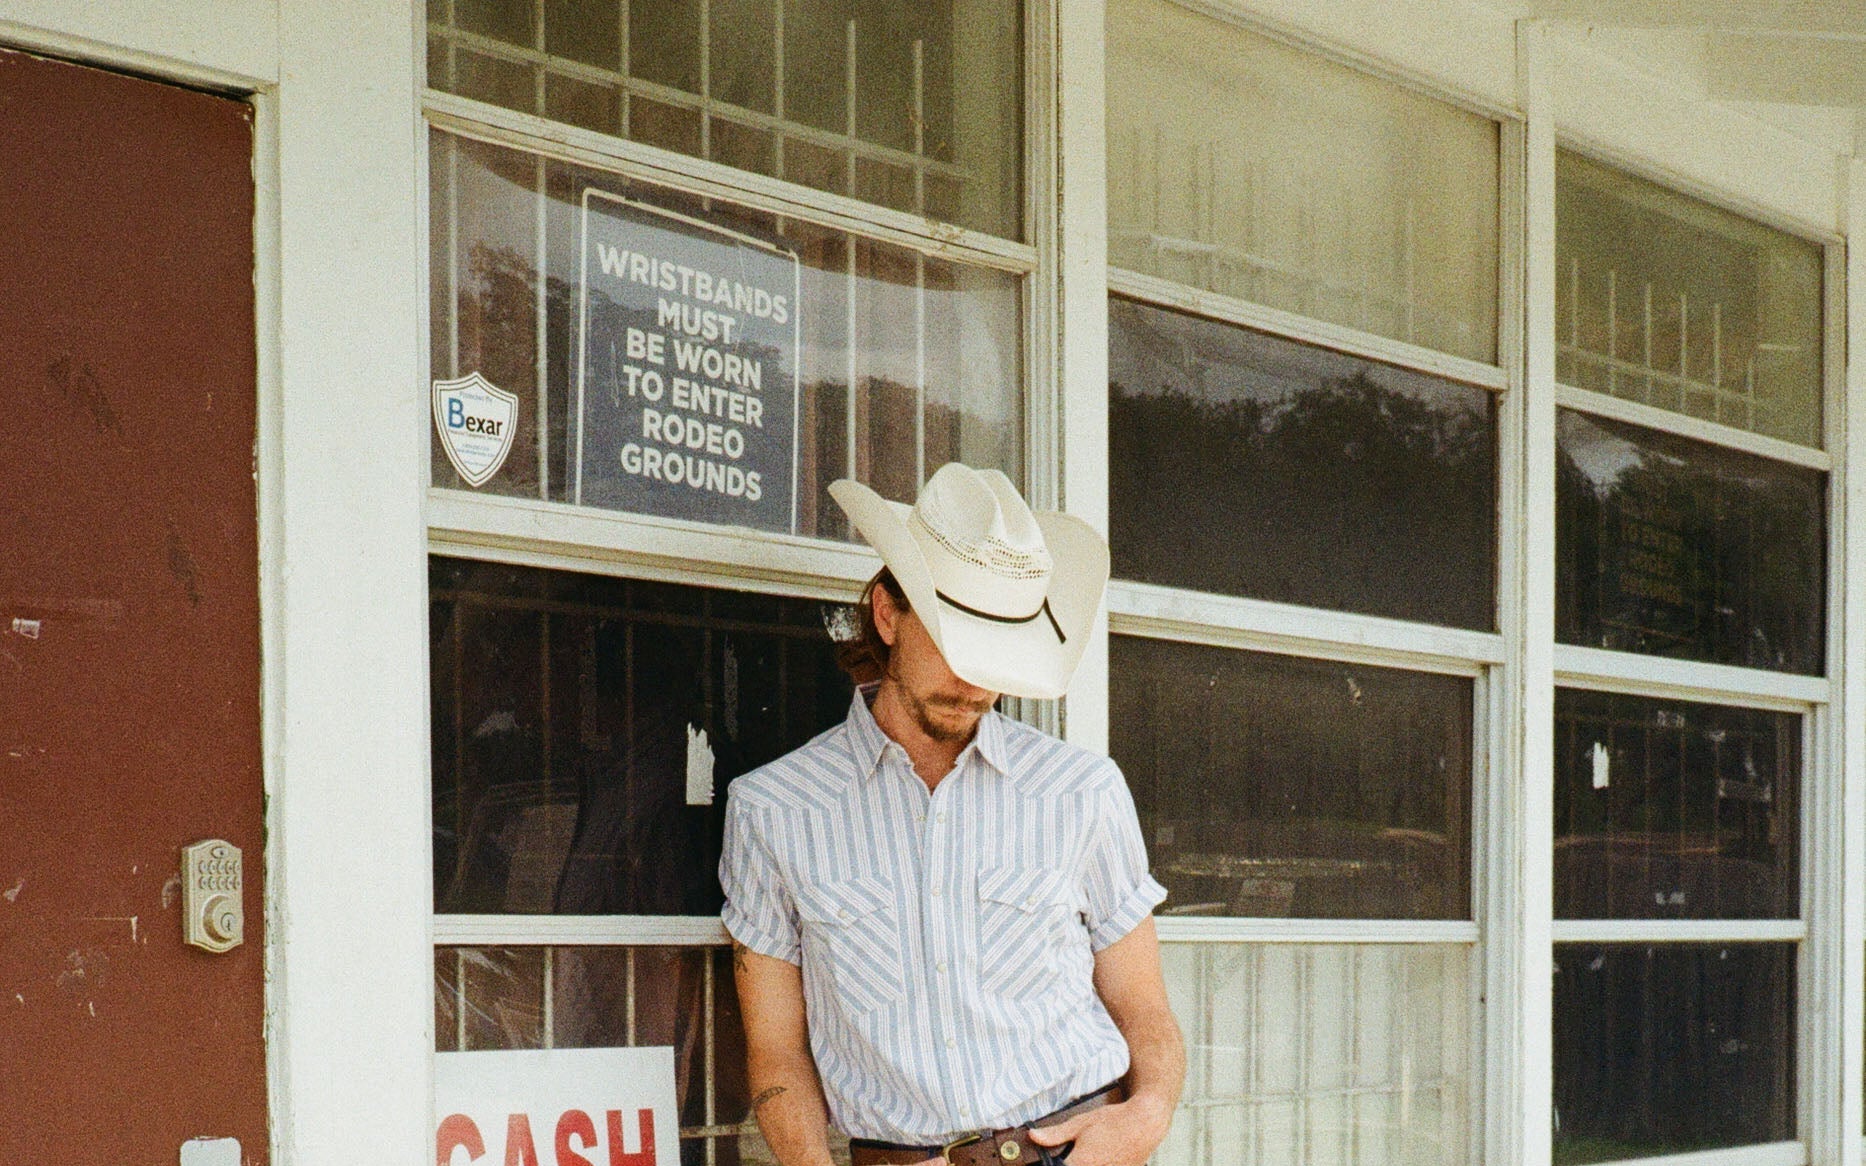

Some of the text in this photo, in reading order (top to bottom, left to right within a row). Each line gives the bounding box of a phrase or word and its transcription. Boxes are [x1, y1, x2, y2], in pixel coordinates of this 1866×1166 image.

[597, 243, 788, 324] WRISTBANDS
[658, 298, 735, 344] MUST
[626, 327, 762, 391] BE WORN
[448, 397, 503, 436] Bexar
[623, 364, 763, 428] TO ENTER
[643, 408, 744, 460] RODEO
[621, 443, 763, 502] GROUNDS
